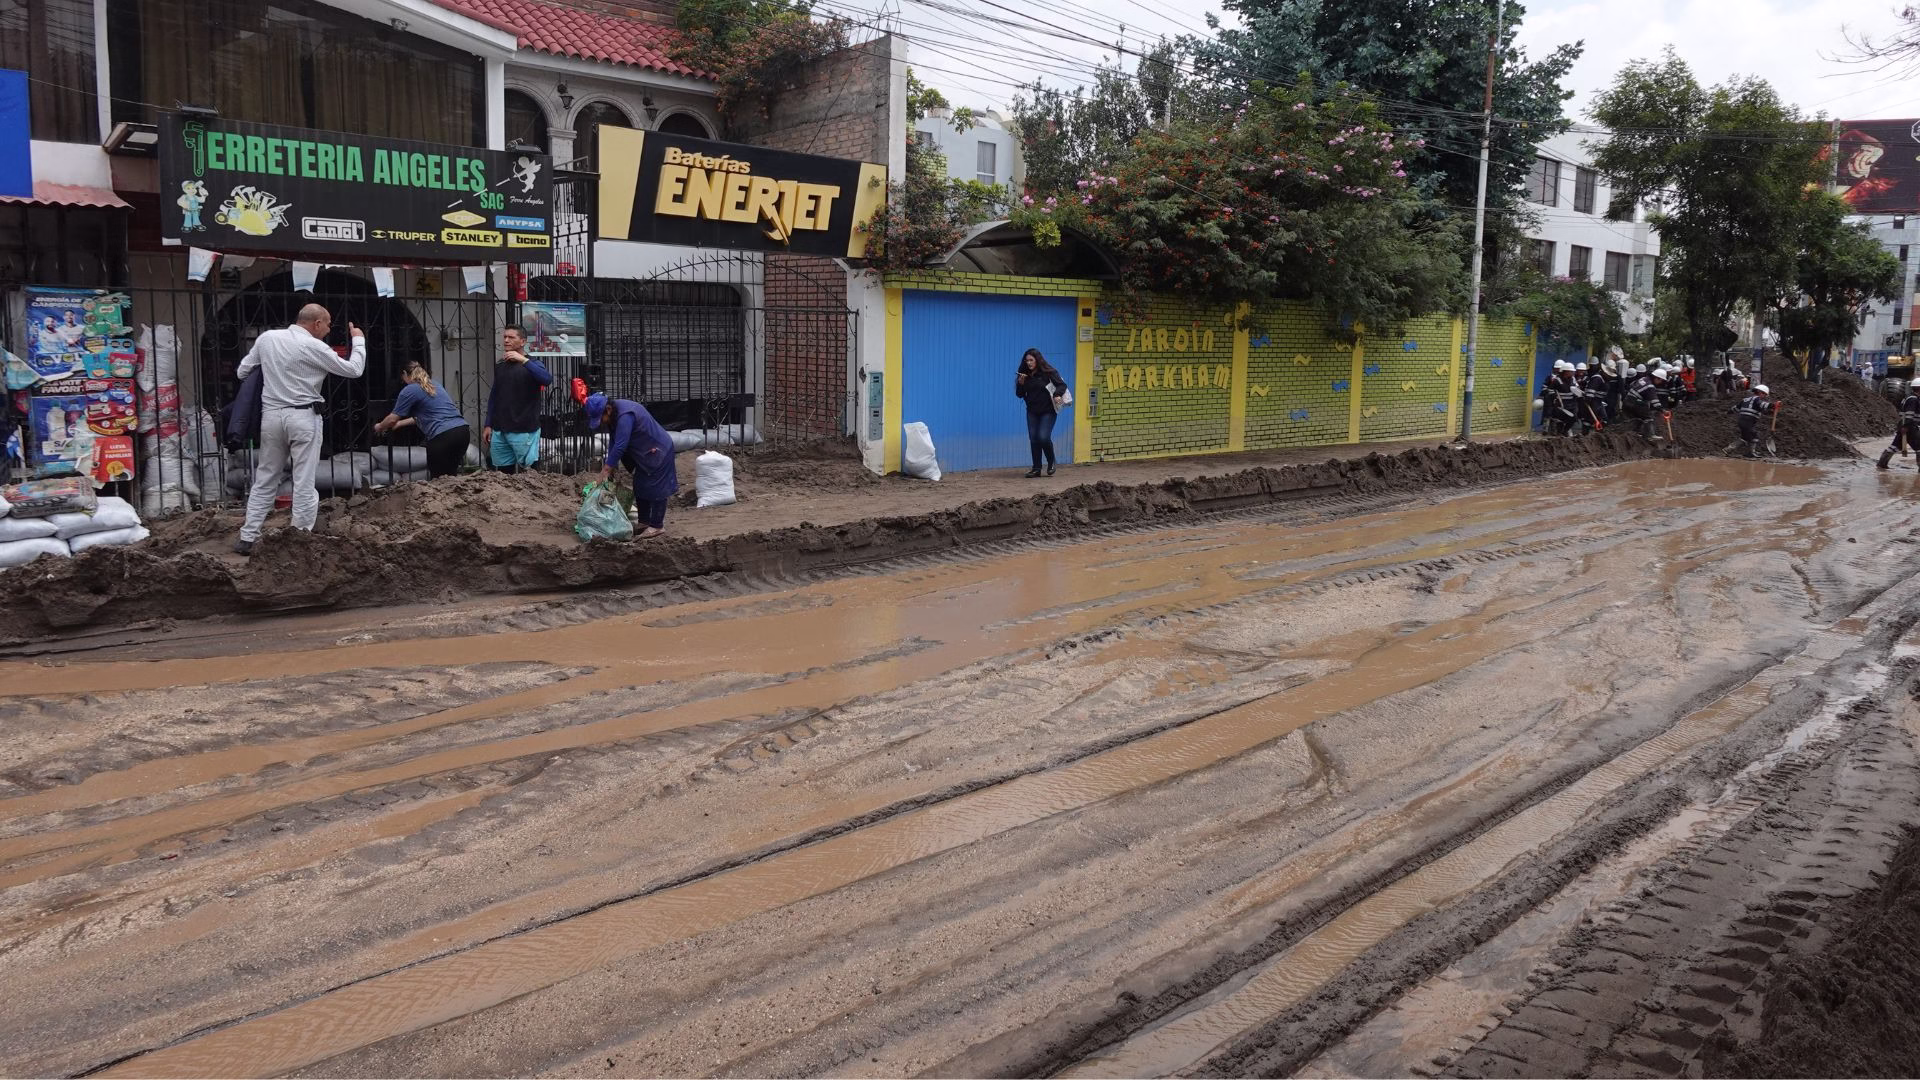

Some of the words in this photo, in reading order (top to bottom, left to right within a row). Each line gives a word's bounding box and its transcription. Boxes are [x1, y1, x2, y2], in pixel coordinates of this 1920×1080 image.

[373, 148, 486, 193] ANGELES
[664, 146, 751, 174] Baterías
[480, 191, 505, 210] SAC
[654, 164, 841, 247] ENERJET
[498, 218, 543, 229] ANYPSA
[387, 230, 436, 242] TRUPER
[446, 232, 498, 243] STANLEY
[1107, 364, 1230, 392] MARKHAM
